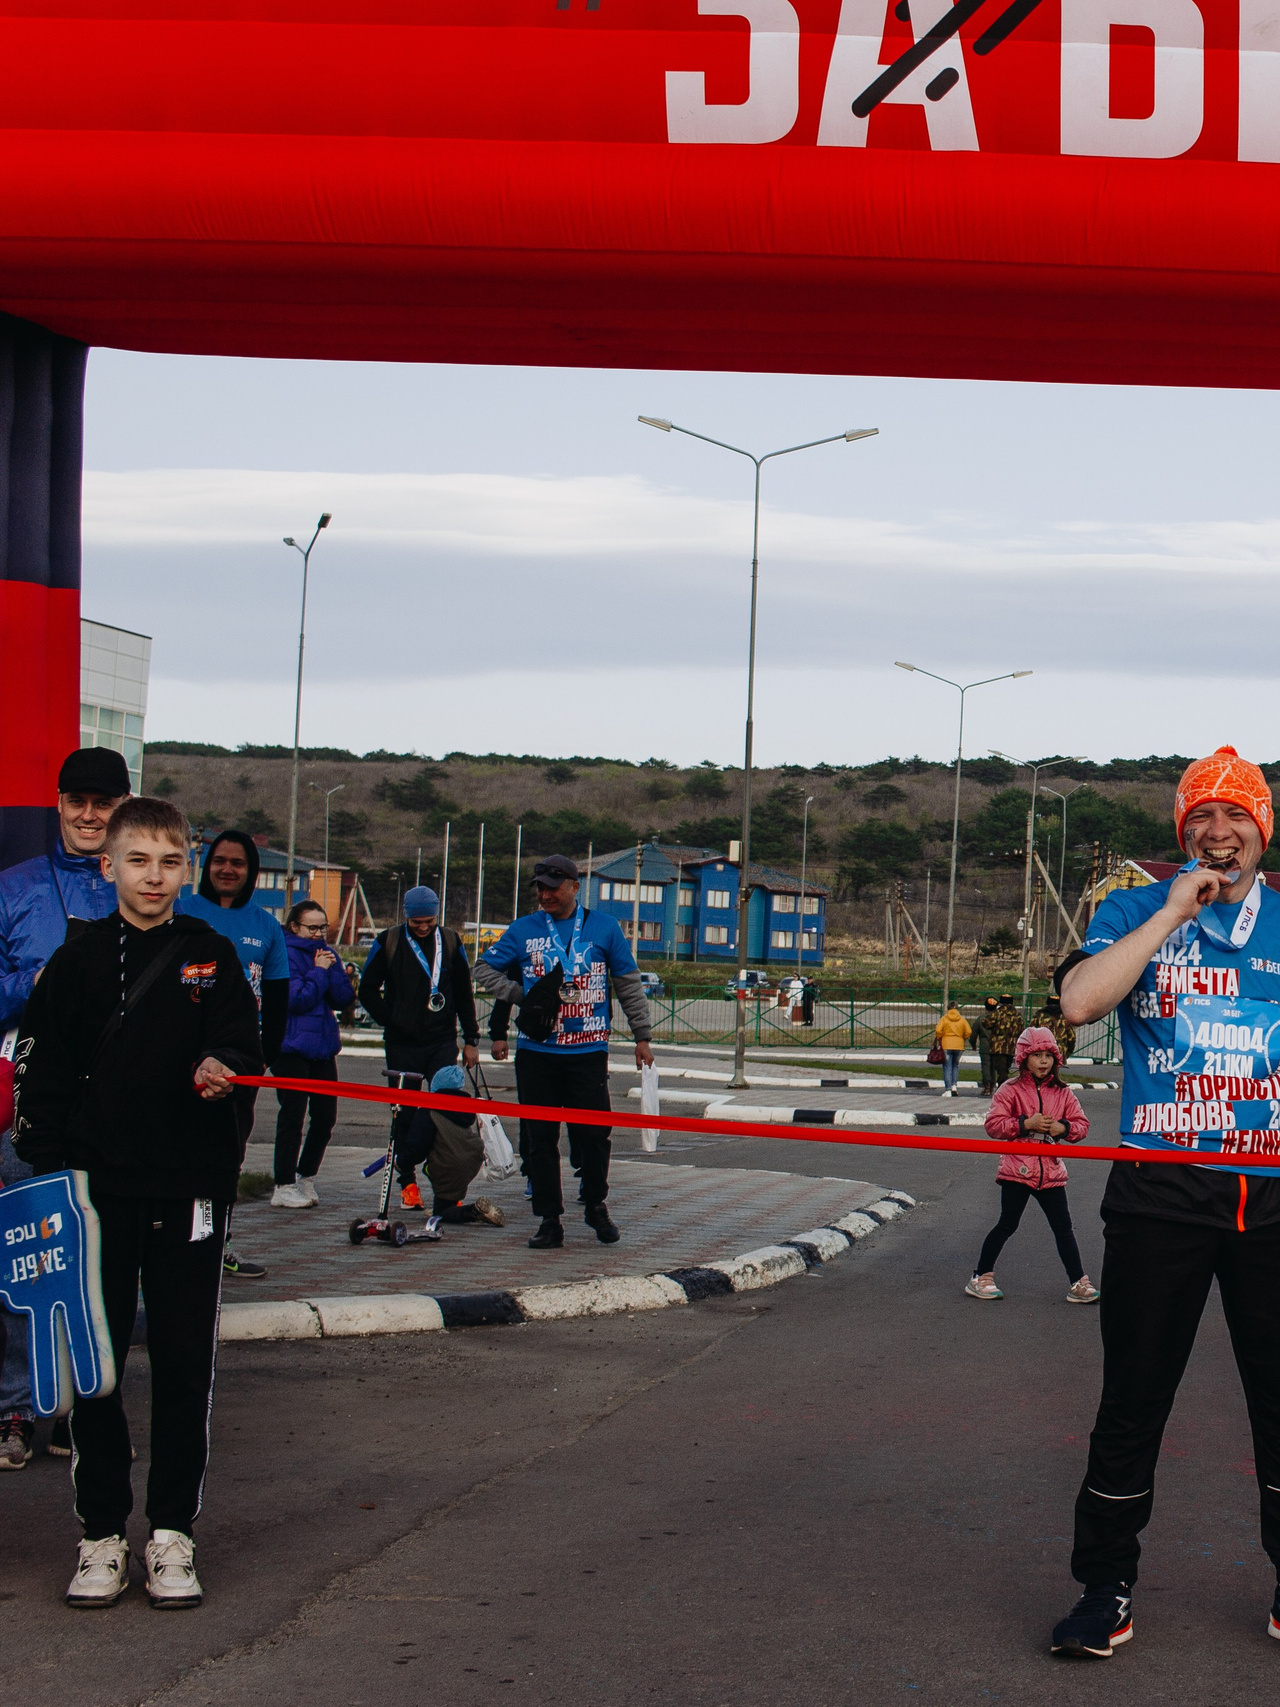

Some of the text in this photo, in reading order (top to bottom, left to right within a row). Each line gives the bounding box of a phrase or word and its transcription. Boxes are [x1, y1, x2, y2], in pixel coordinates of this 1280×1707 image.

[1239, 914, 1252, 932] ПСБ
[526, 936, 552, 953] 2024
[1156, 964, 1239, 996] #МЕЧТА
[1194, 998, 1211, 1006] ПСБ
[583, 1016, 606, 1031] 2024
[1195, 1021, 1266, 1053] 40004
[1132, 1102, 1236, 1133] #ЛЮБОВЬ
[4, 1223, 37, 1246] ПСБ
